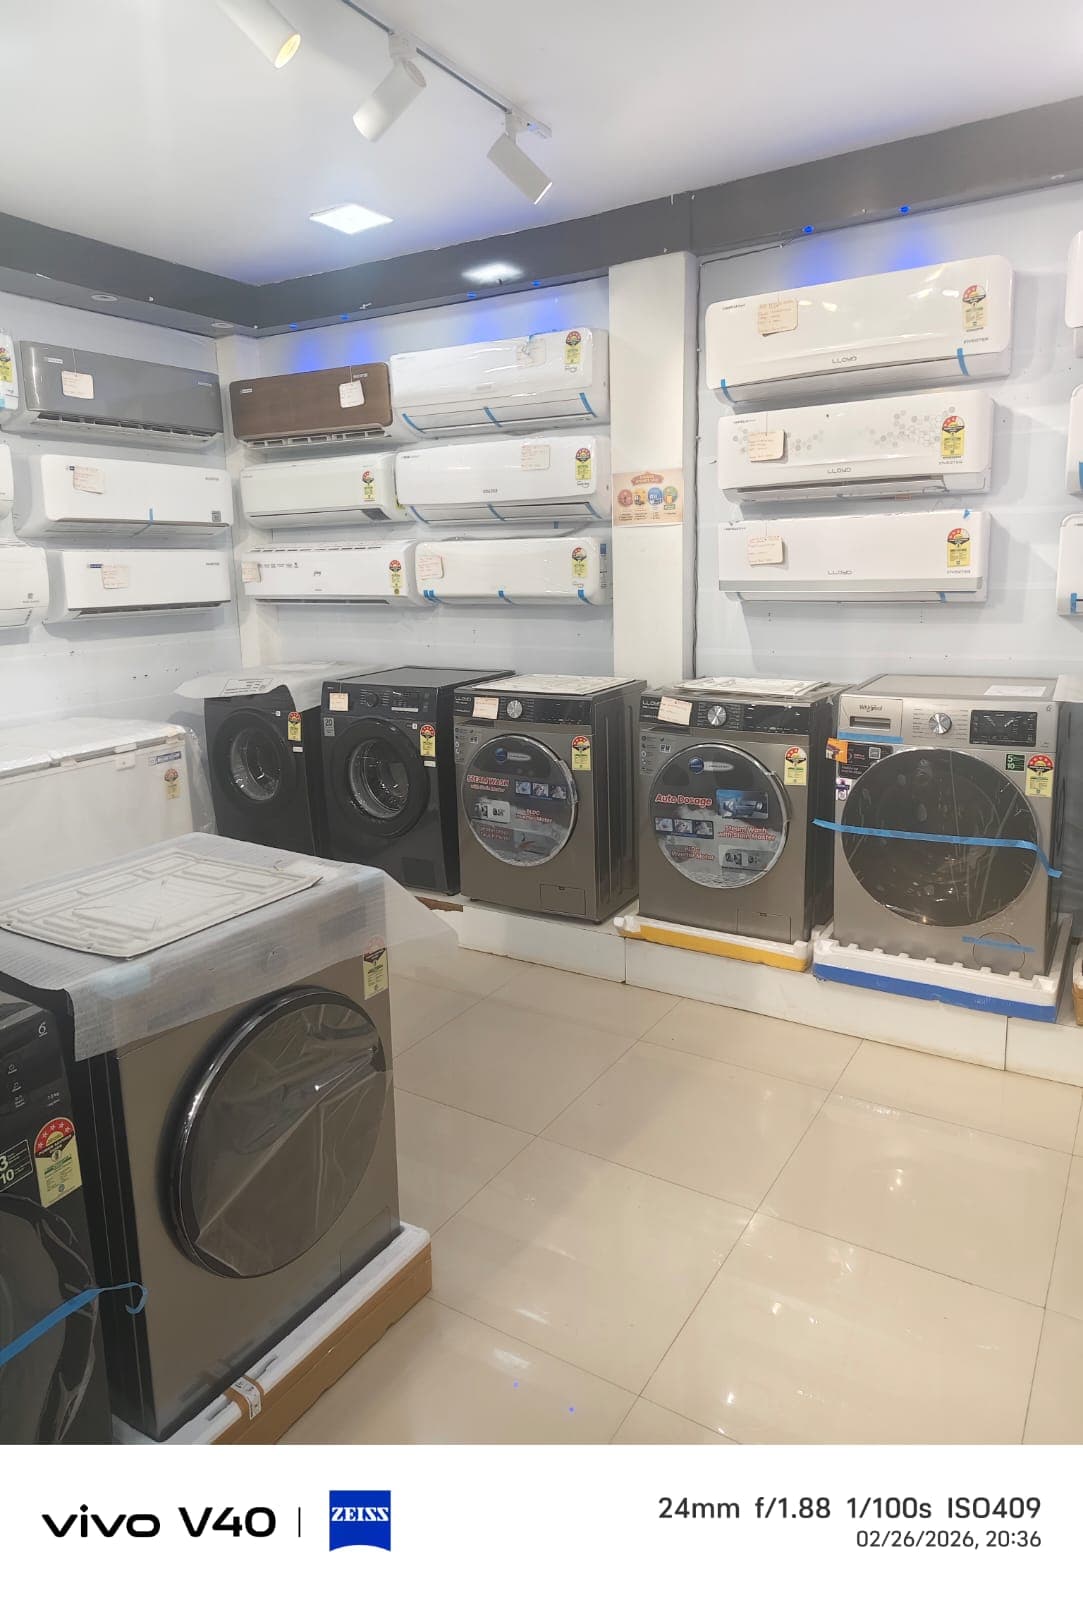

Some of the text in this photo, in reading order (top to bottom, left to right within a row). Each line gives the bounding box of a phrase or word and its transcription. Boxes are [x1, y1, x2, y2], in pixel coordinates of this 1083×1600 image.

[831, 355, 857, 364] LLOYD
[827, 466, 852, 474] LLOYD
[655, 793, 713, 809] Auto Dosage
